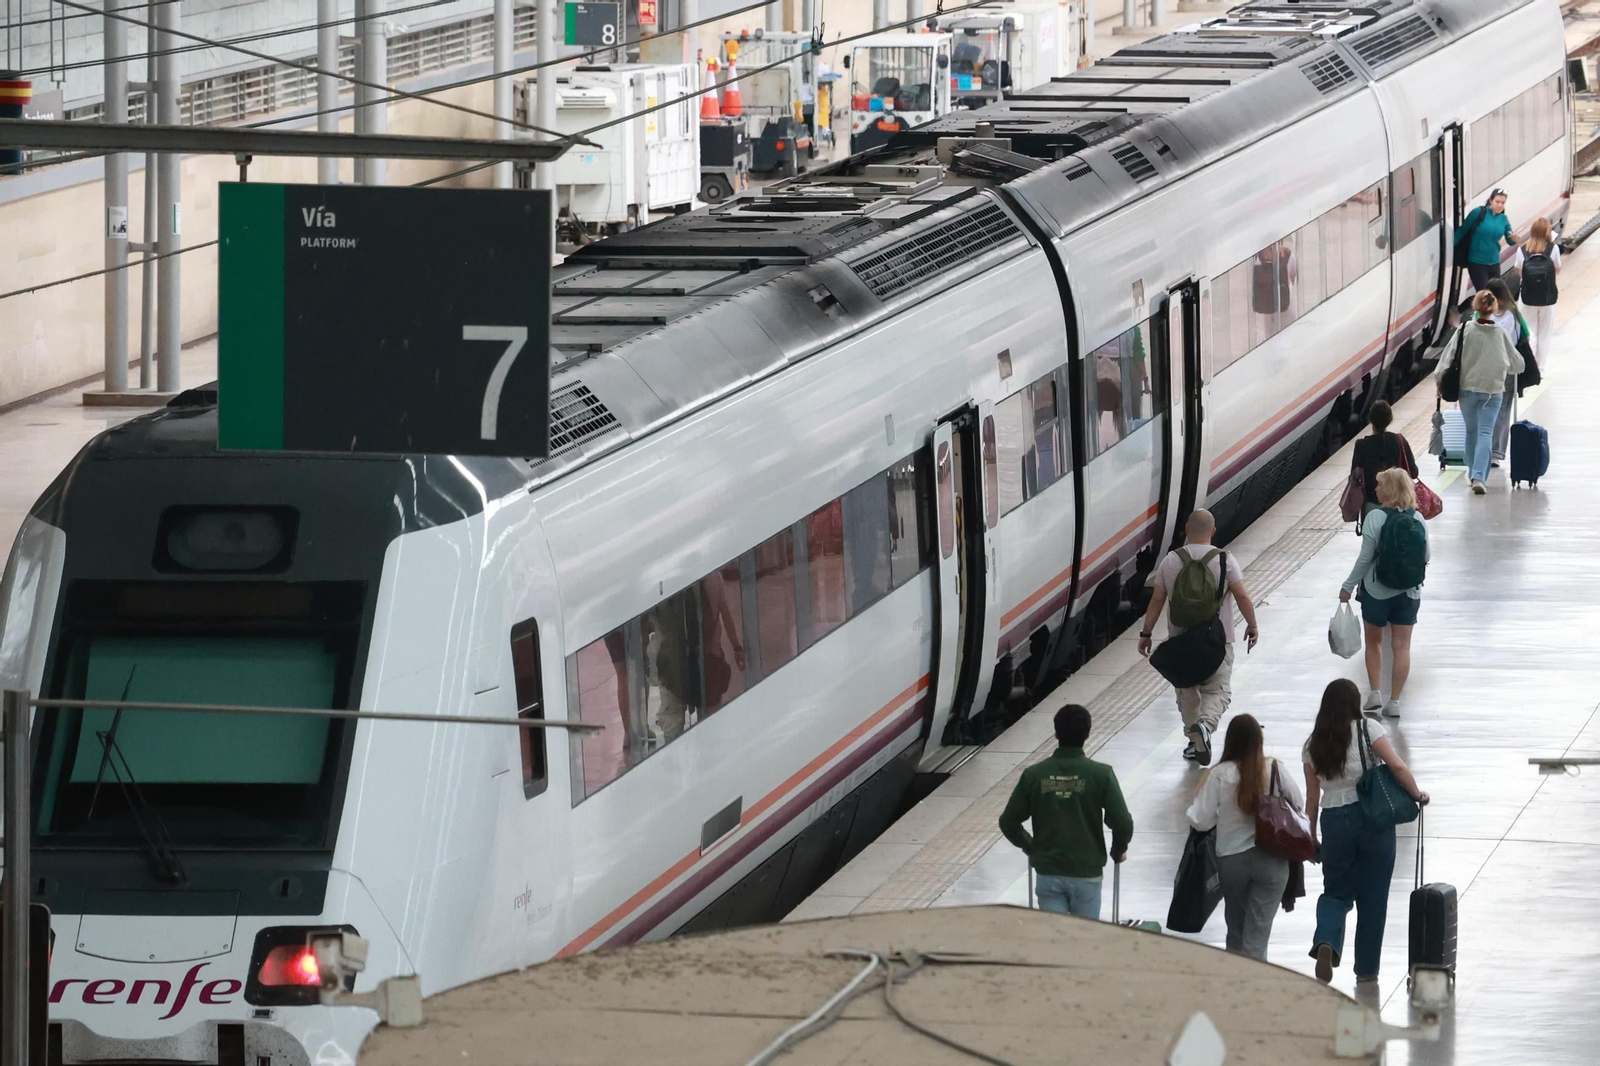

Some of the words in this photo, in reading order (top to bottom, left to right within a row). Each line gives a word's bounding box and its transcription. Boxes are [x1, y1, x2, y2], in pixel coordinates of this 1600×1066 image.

[602, 24, 615, 45] 8
[301, 205, 336, 228] Vía
[300, 237, 356, 248] PLATFORM
[462, 325, 528, 441] 7
[49, 962, 242, 1020] renfe
